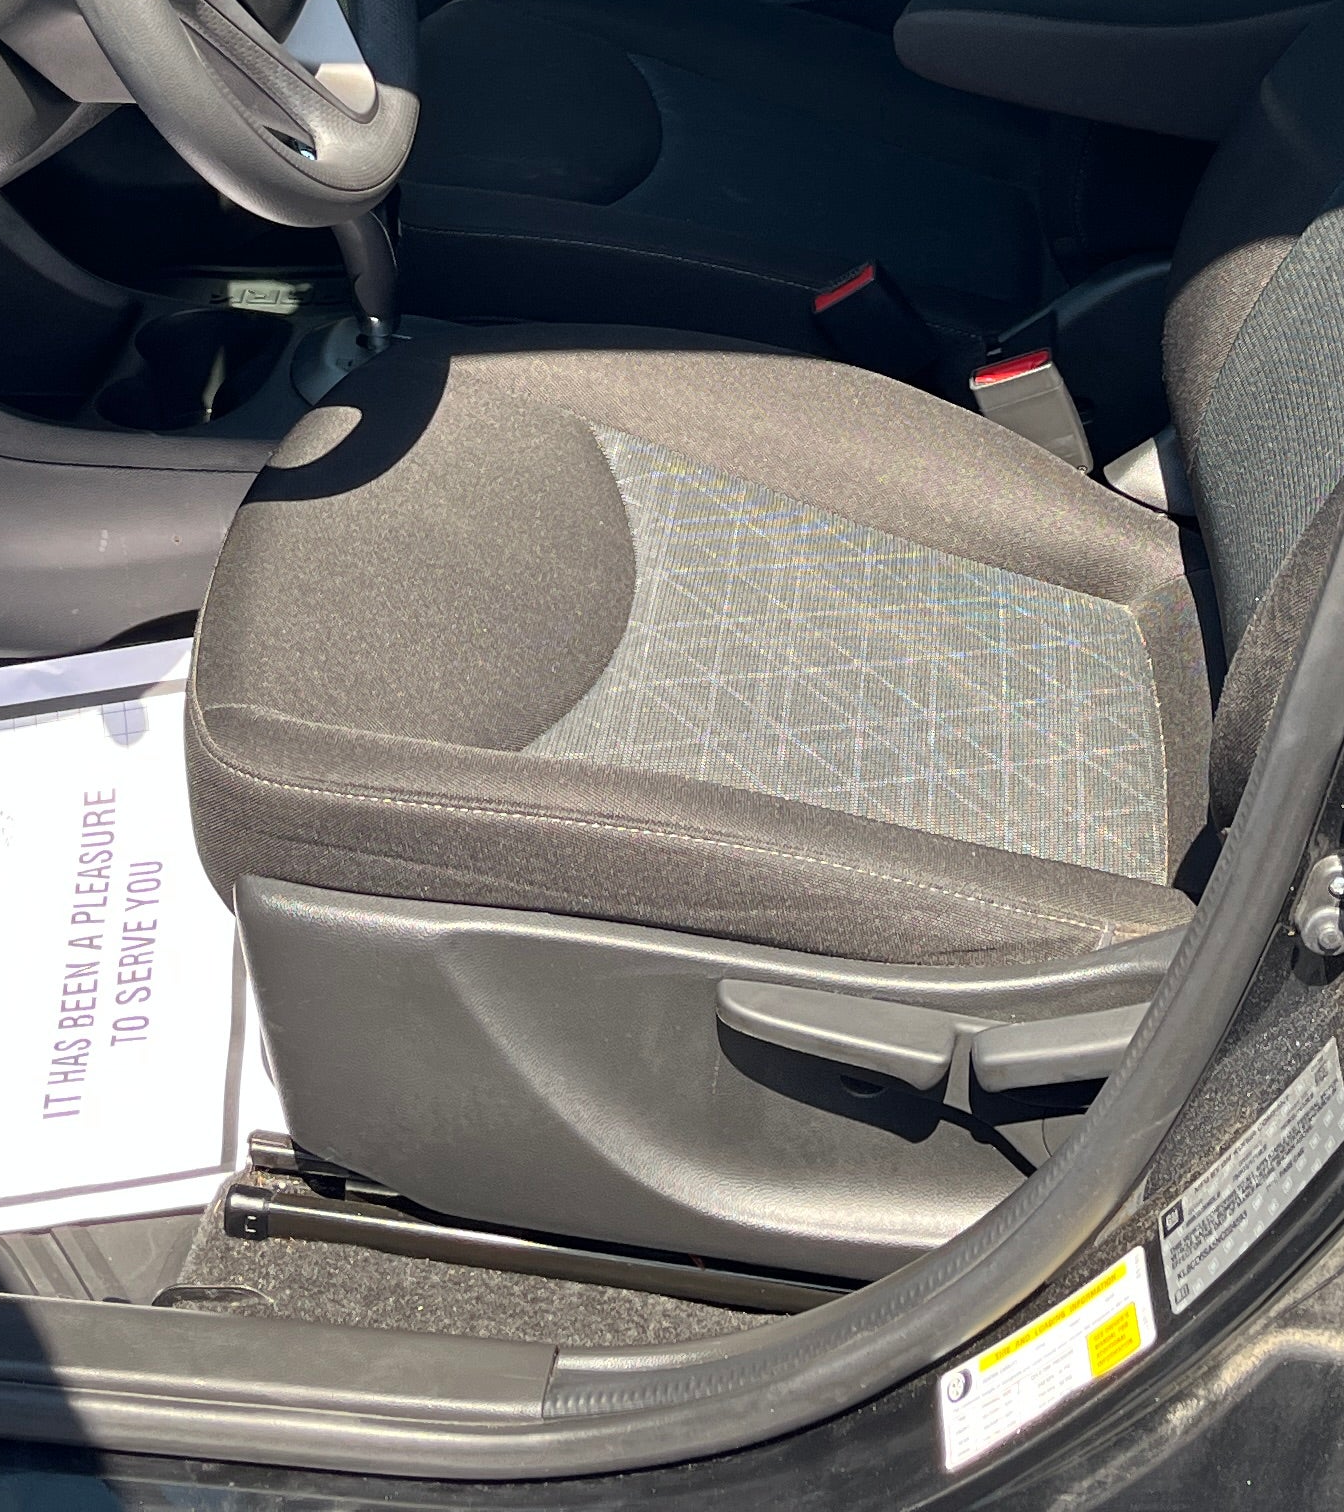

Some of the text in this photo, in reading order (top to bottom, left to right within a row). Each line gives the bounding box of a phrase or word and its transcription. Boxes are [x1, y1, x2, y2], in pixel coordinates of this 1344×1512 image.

[42, 788, 116, 1119] IT HAS BEEN A PLEASURE
[110, 861, 163, 1047] TO SERVE YOU
[994, 1274, 1117, 1361] TIRE AND LOADING INFORMATION
